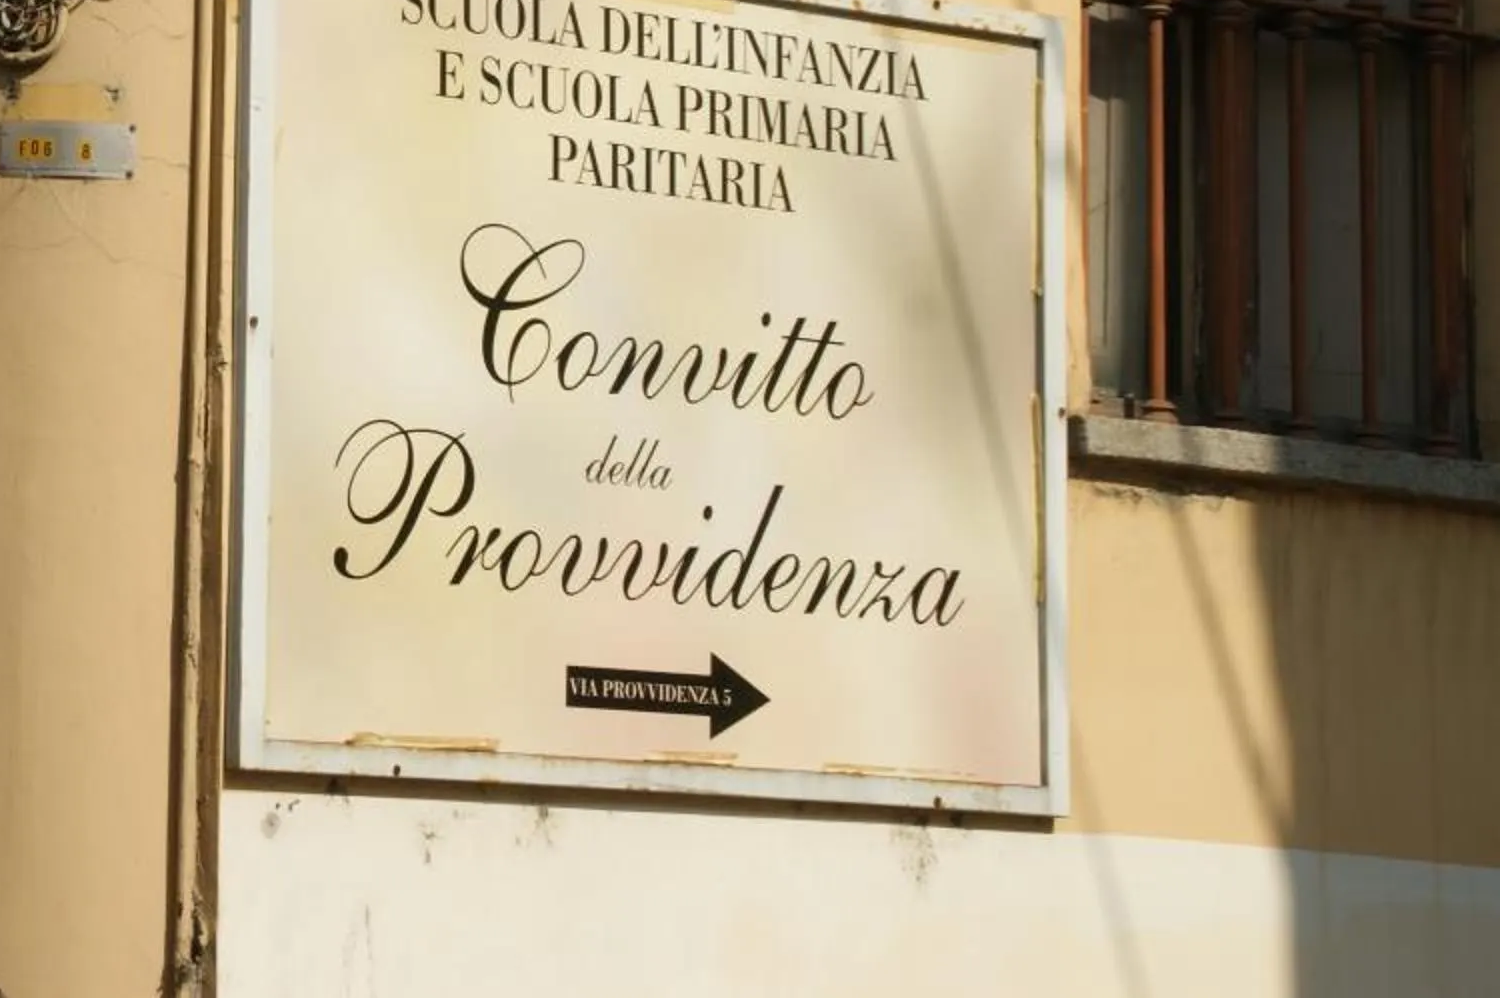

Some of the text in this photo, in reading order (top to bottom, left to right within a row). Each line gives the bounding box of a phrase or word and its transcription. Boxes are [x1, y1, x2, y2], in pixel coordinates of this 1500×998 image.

[601, 4, 929, 102] DELL'INFANZIA
[436, 51, 898, 162] E SCUOLA PRIMARIA
[547, 134, 796, 214] PARITARIA
[460, 223, 875, 421] Convitto
[584, 434, 675, 492] della
[332, 418, 966, 629] Provvidenza
[569, 676, 732, 707] VIA PROVVIDENZA 5
